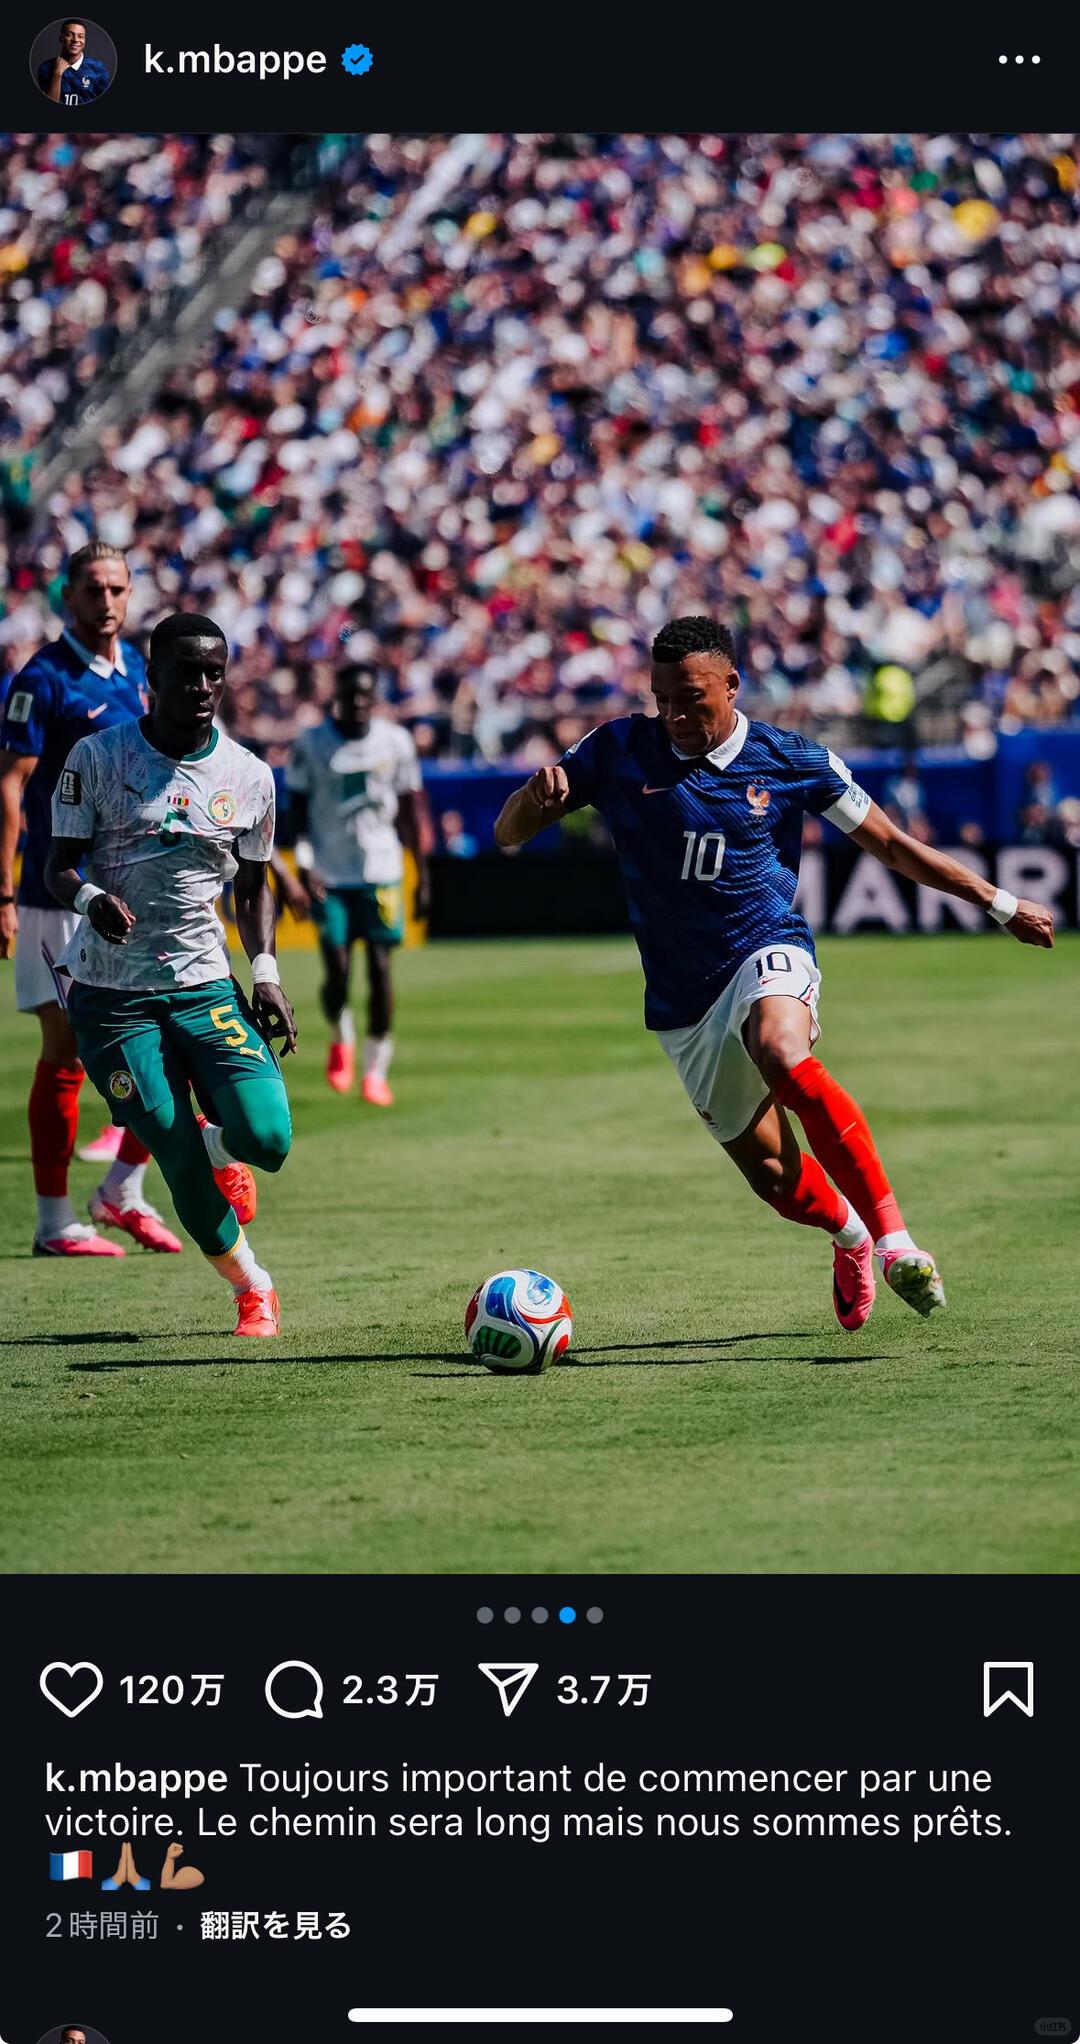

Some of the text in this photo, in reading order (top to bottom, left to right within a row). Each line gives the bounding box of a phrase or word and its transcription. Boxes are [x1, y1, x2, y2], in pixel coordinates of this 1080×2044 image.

[681, 831, 726, 881] 10
[755, 951, 792, 979] 10
[210, 1004, 248, 1047] 5
